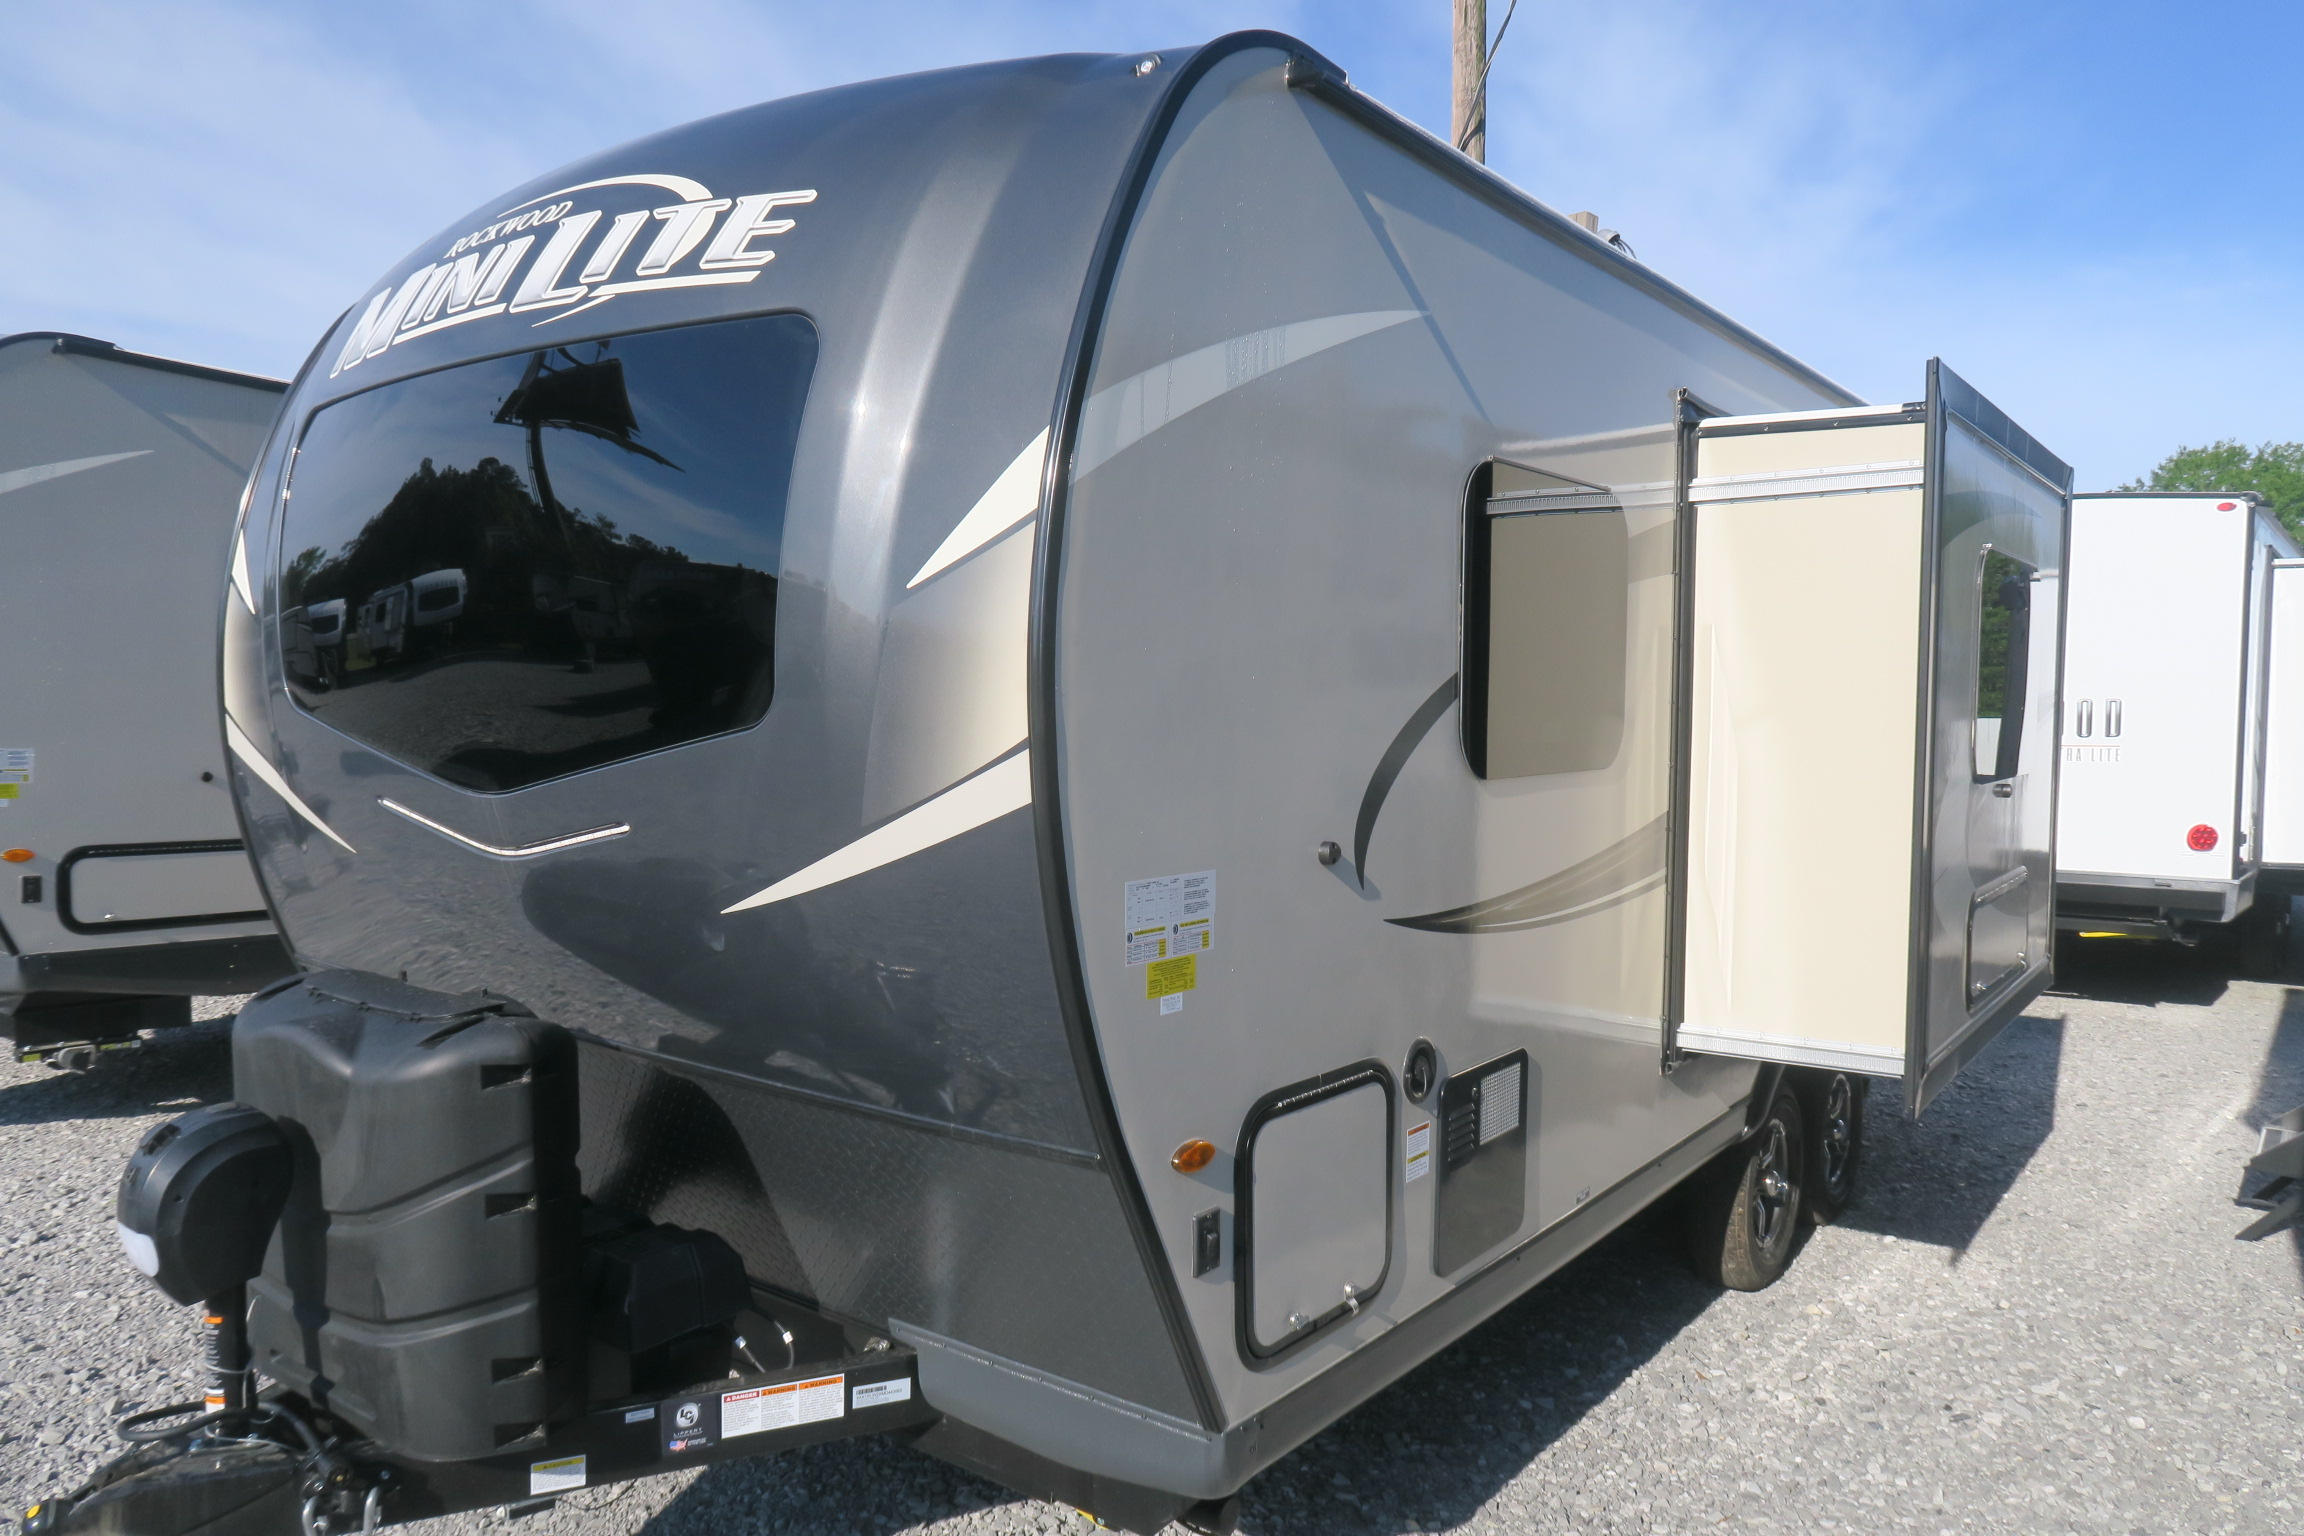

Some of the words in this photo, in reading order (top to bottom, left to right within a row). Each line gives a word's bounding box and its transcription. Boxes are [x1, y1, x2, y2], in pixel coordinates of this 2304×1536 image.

[443, 200, 574, 259] ROCKWOOD
[2091, 747, 2120, 762] LITE
[809, 1378, 837, 1388] WARNING
[767, 1386, 796, 1395] WARNING
[731, 1391, 758, 1401] DANGER
